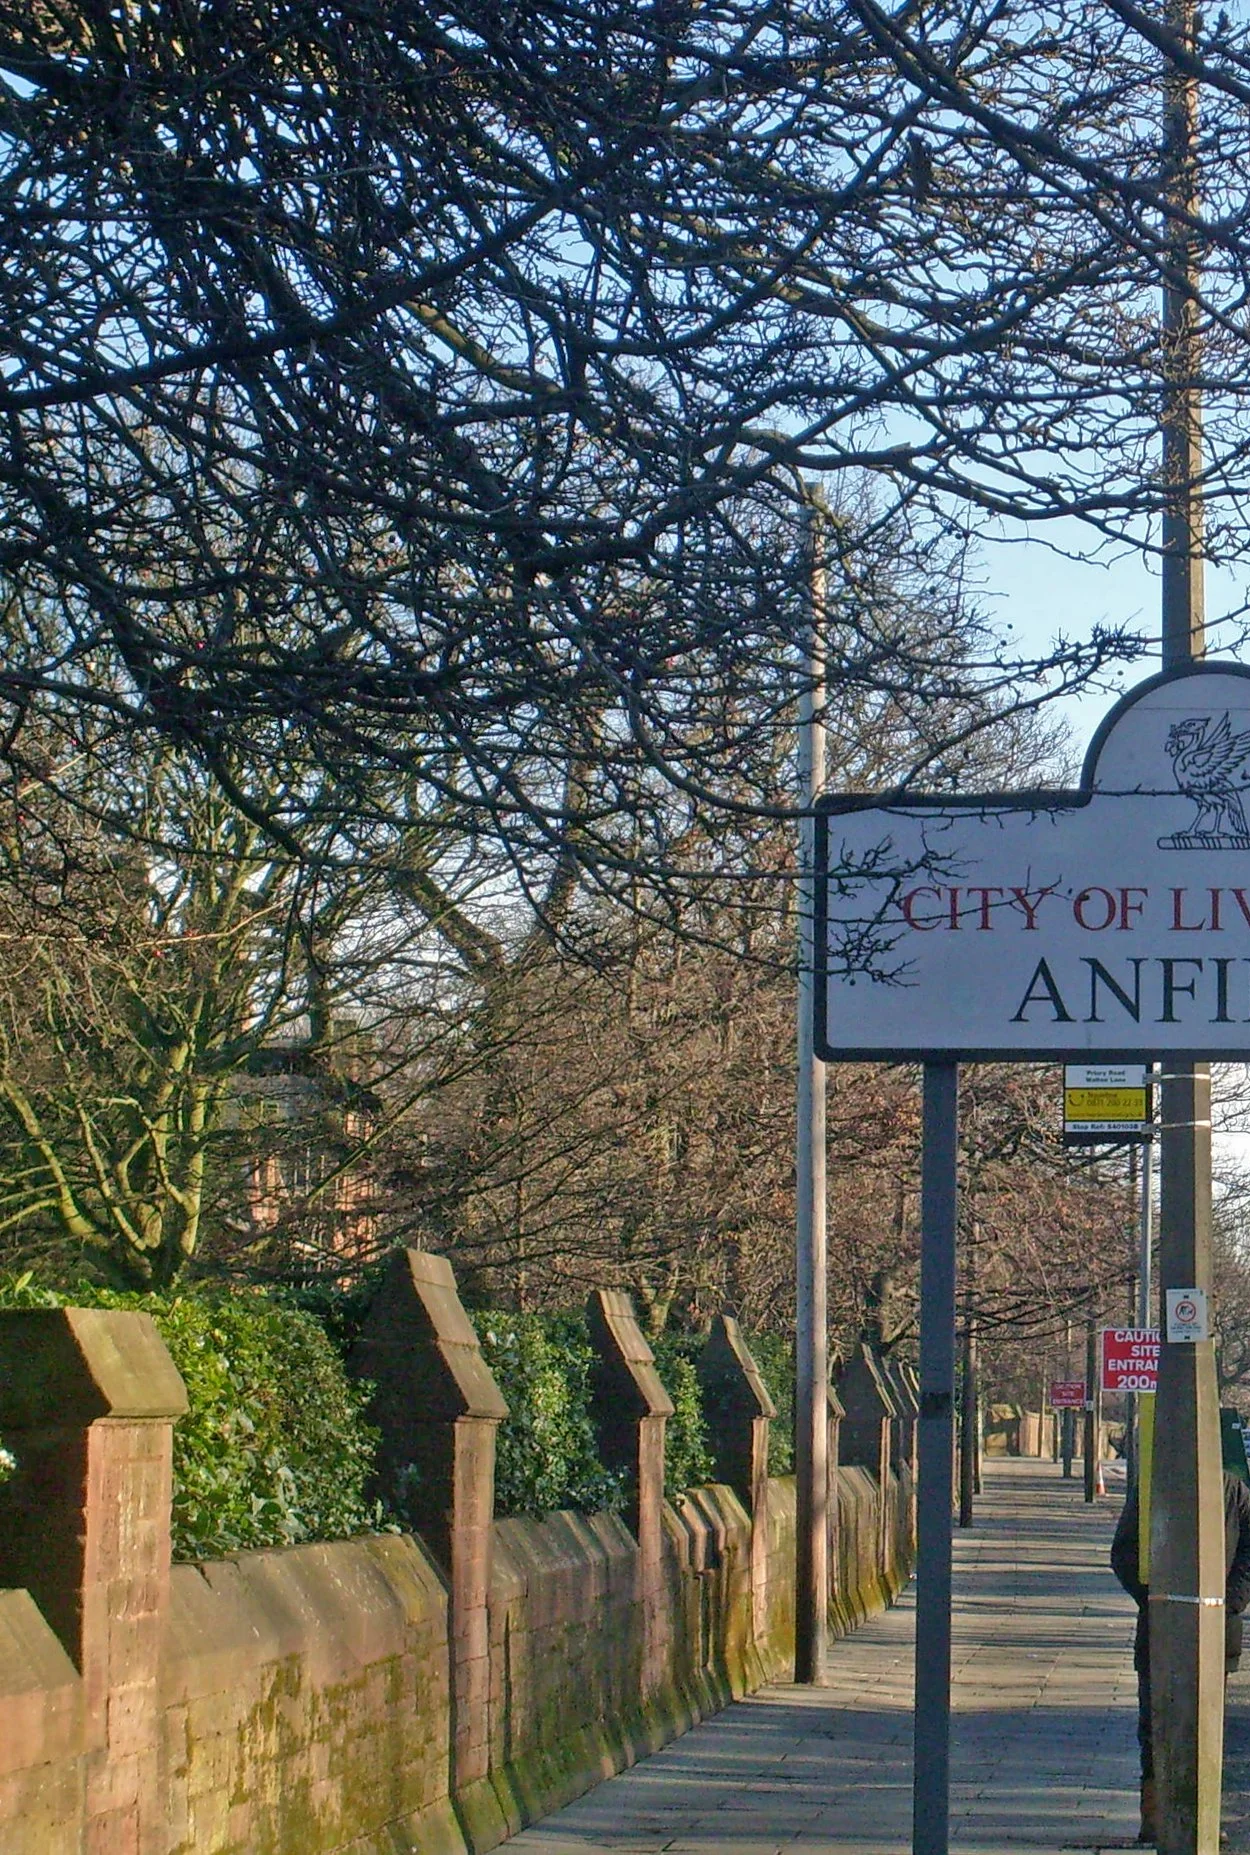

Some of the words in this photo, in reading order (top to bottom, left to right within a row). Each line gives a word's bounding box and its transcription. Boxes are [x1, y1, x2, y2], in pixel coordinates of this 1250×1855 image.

[903, 886, 1051, 931] CITY
[1073, 886, 1148, 931] OF
[1131, 1345, 1160, 1357] SITE
